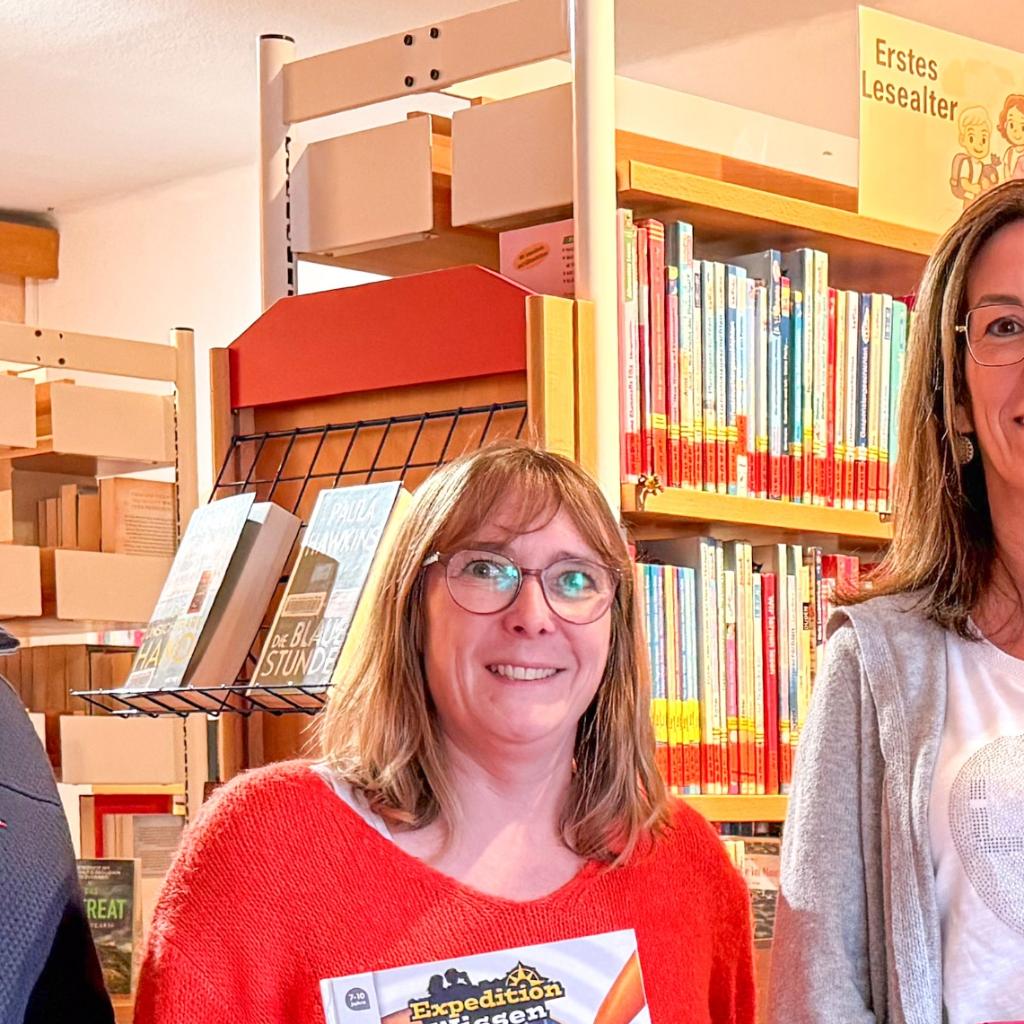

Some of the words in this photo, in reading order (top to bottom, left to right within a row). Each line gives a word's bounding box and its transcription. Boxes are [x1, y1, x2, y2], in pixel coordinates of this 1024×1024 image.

[876, 38, 938, 81] Erstes
[862, 70, 958, 121] Lesealter
[328, 500, 374, 524] PAULA
[304, 528, 381, 557] HAWKINS
[270, 633, 289, 650] DIE
[290, 616, 348, 650] BLAUE
[261, 646, 340, 678] STUNDE
[84, 898, 128, 920] REAT
[410, 981, 563, 1022] Expedition
